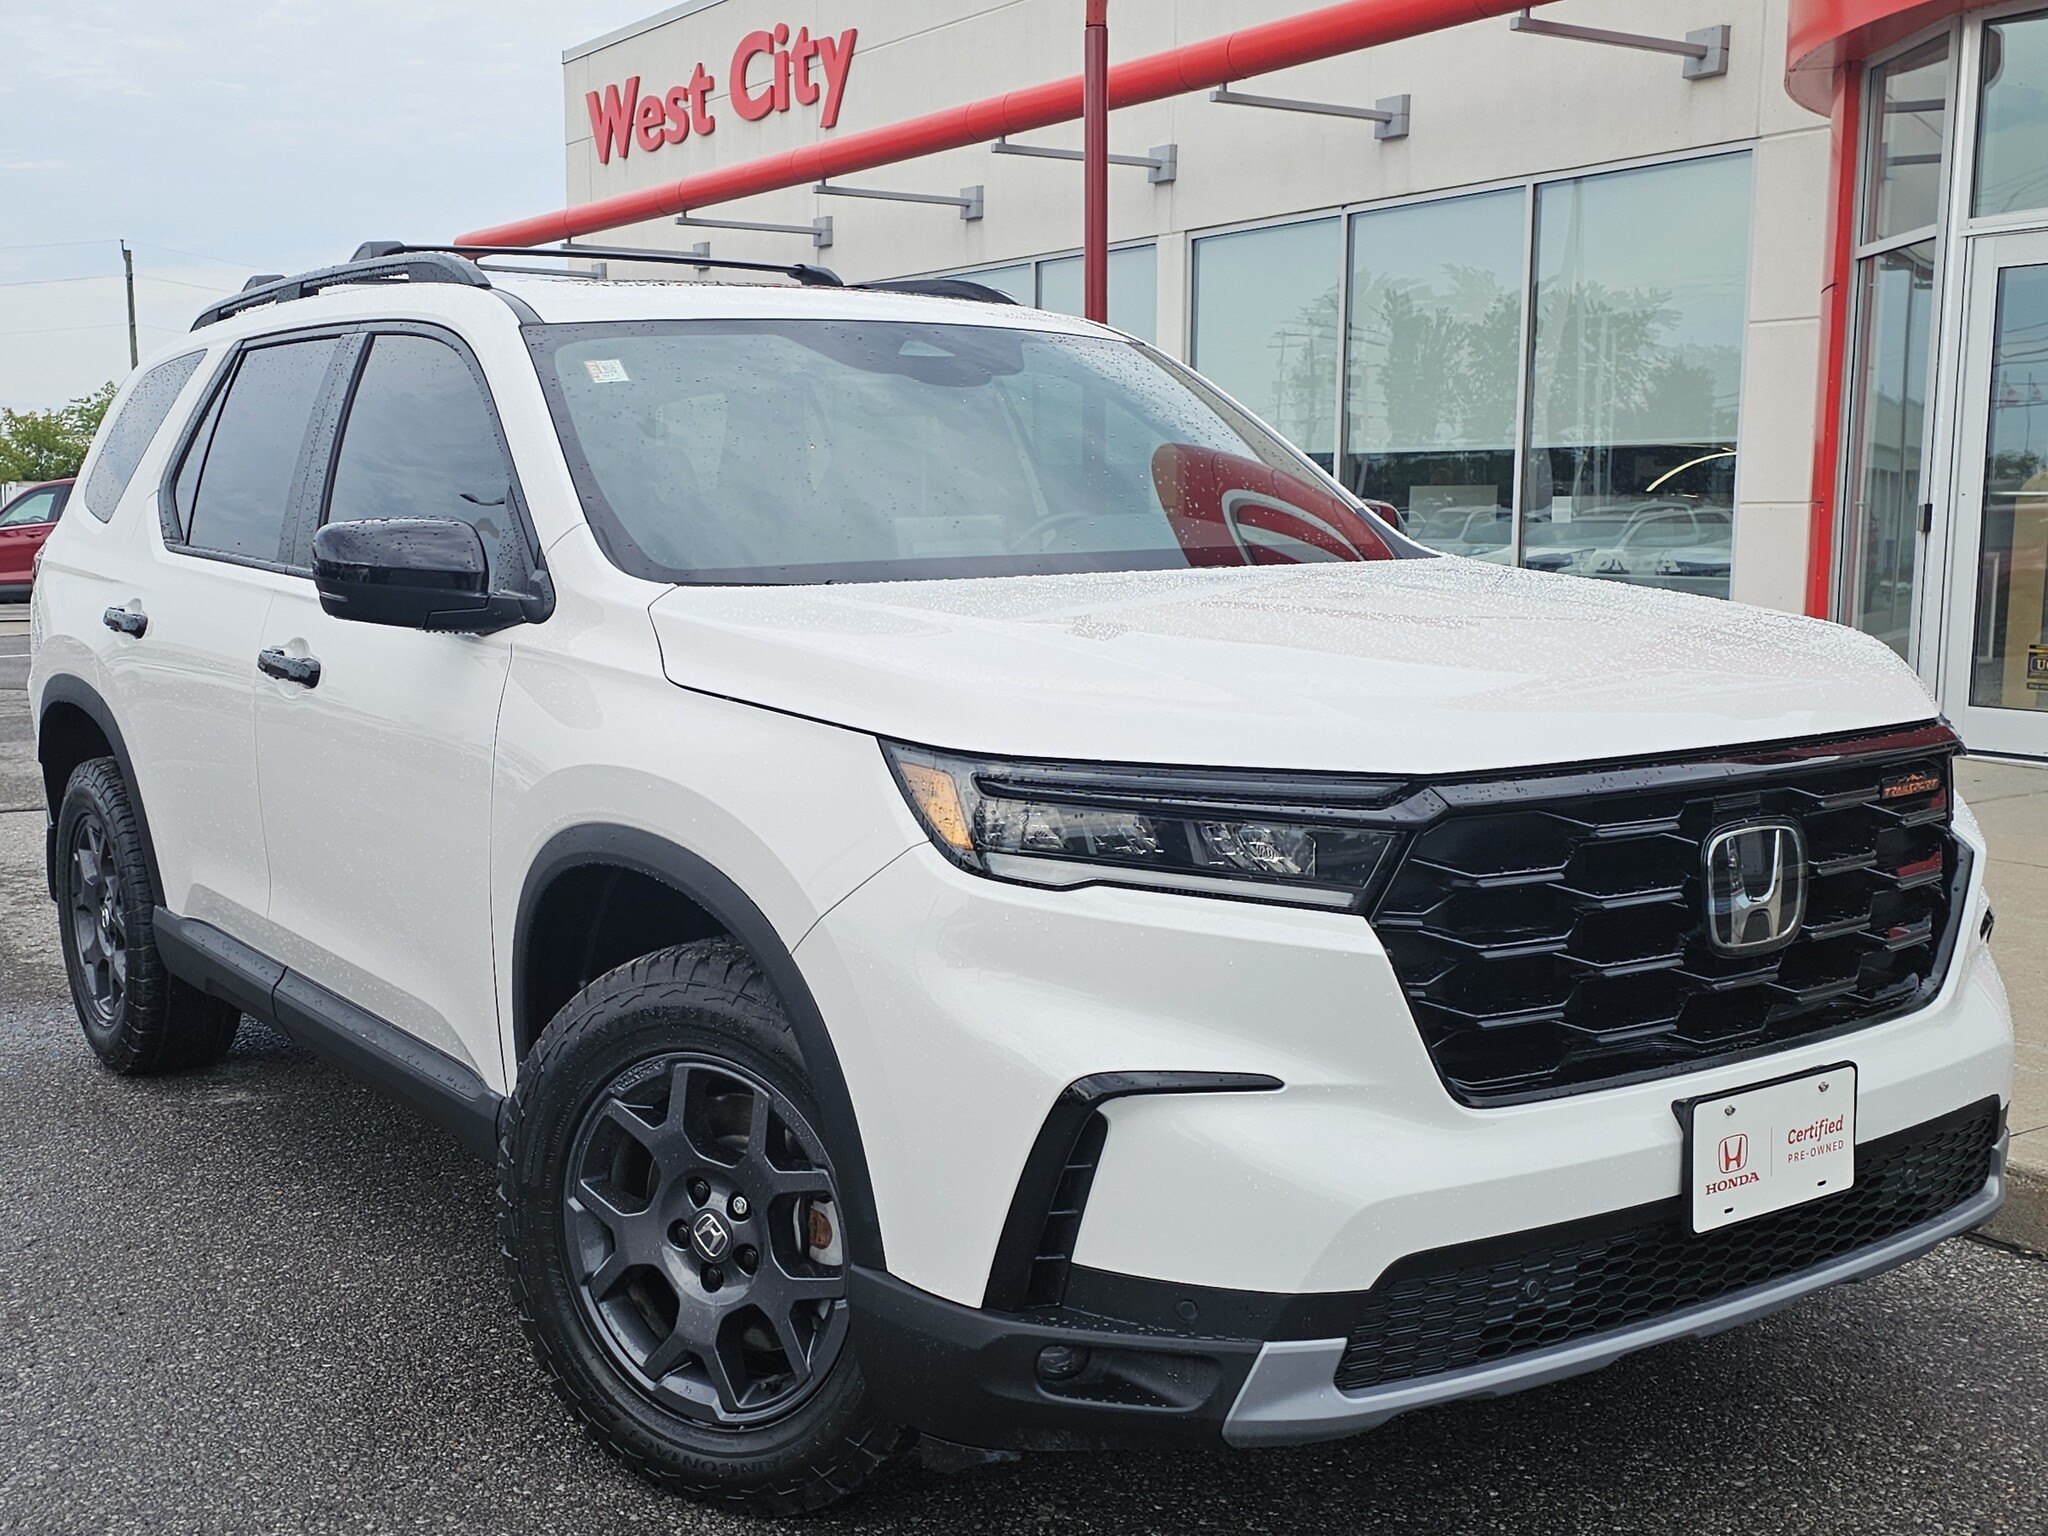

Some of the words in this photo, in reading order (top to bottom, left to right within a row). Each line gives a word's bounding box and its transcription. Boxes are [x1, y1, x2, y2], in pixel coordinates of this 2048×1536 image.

[585, 62, 716, 165] West
[729, 22, 858, 129] City
[1787, 1114, 1844, 1145] Certified
[1787, 1140, 1845, 1164] PRE-OWNED
[1705, 1172, 1760, 1195] HONDA
